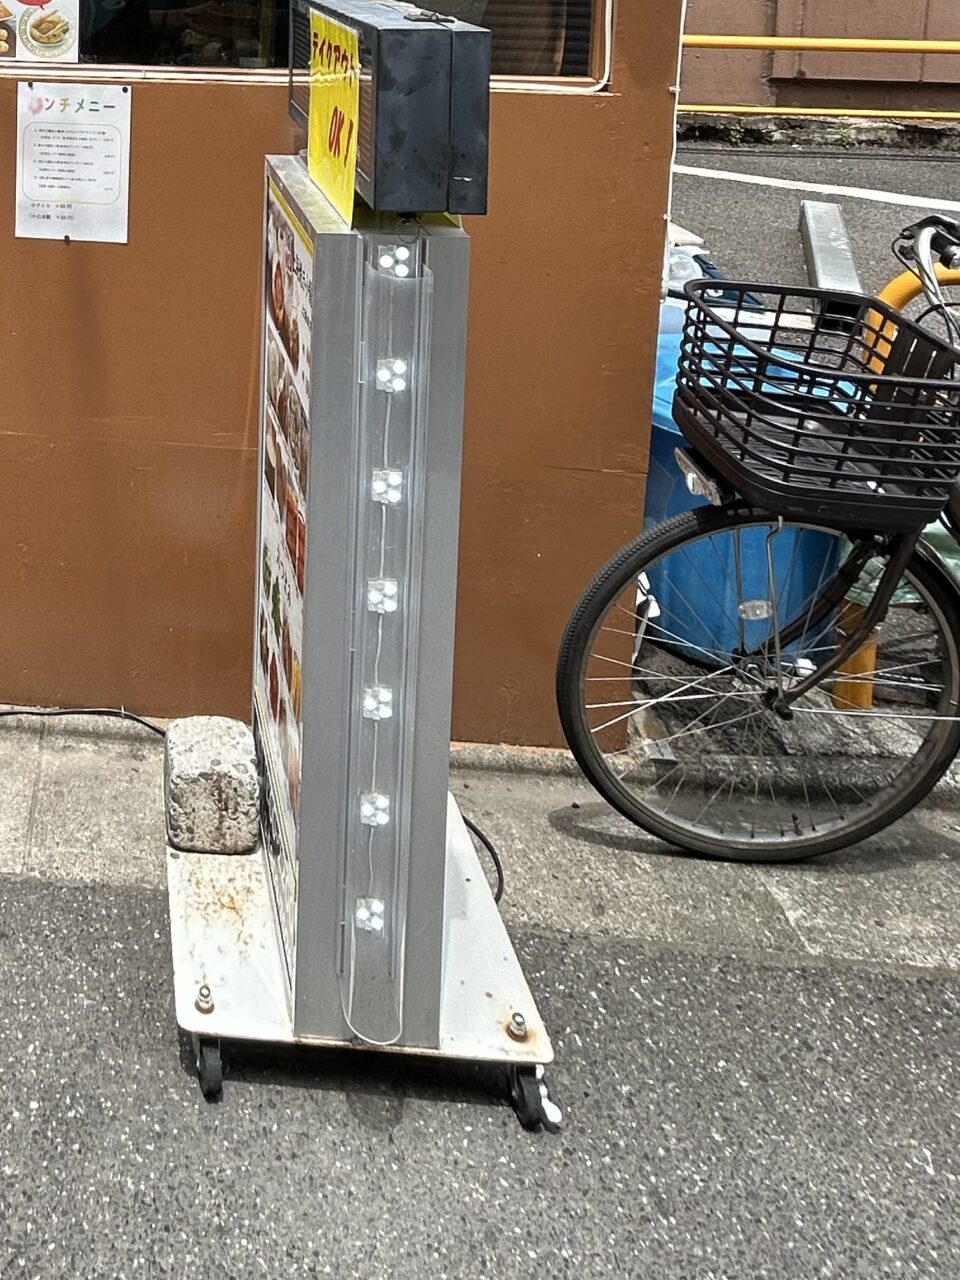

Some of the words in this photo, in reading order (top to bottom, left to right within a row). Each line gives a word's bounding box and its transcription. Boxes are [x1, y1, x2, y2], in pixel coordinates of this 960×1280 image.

[313, 31, 355, 89] テイクアウト
